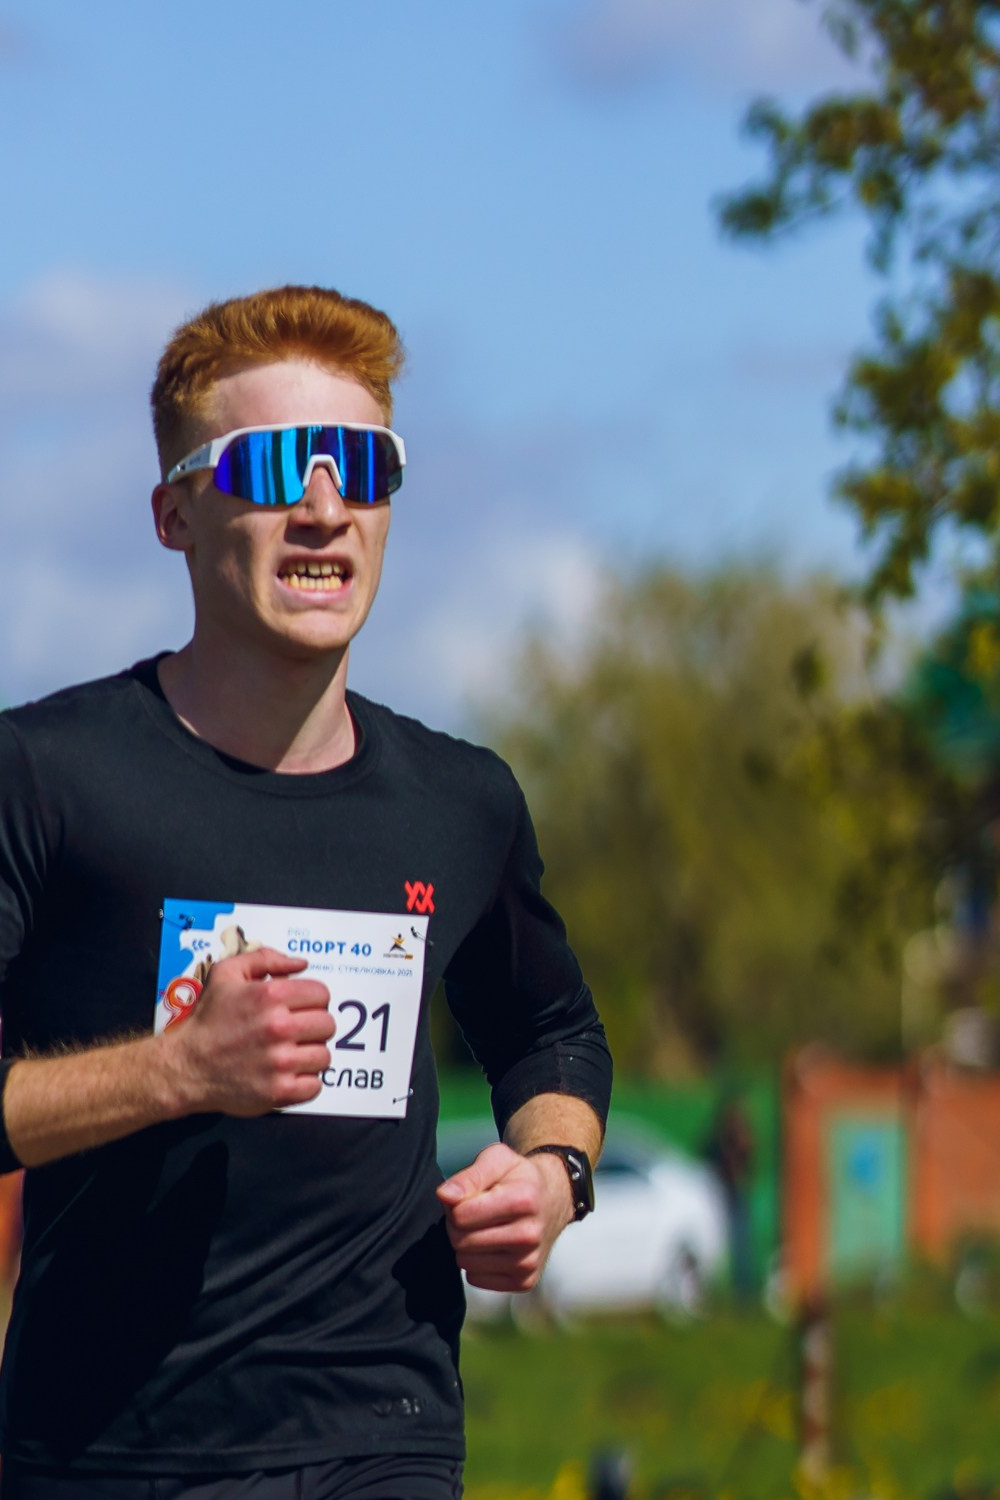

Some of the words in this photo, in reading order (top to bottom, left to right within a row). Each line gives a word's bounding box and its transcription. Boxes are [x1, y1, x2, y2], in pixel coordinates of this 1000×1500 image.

[287, 939, 346, 955] СПОРТ
[350, 943, 372, 957] 40
[335, 1000, 391, 1052] 21
